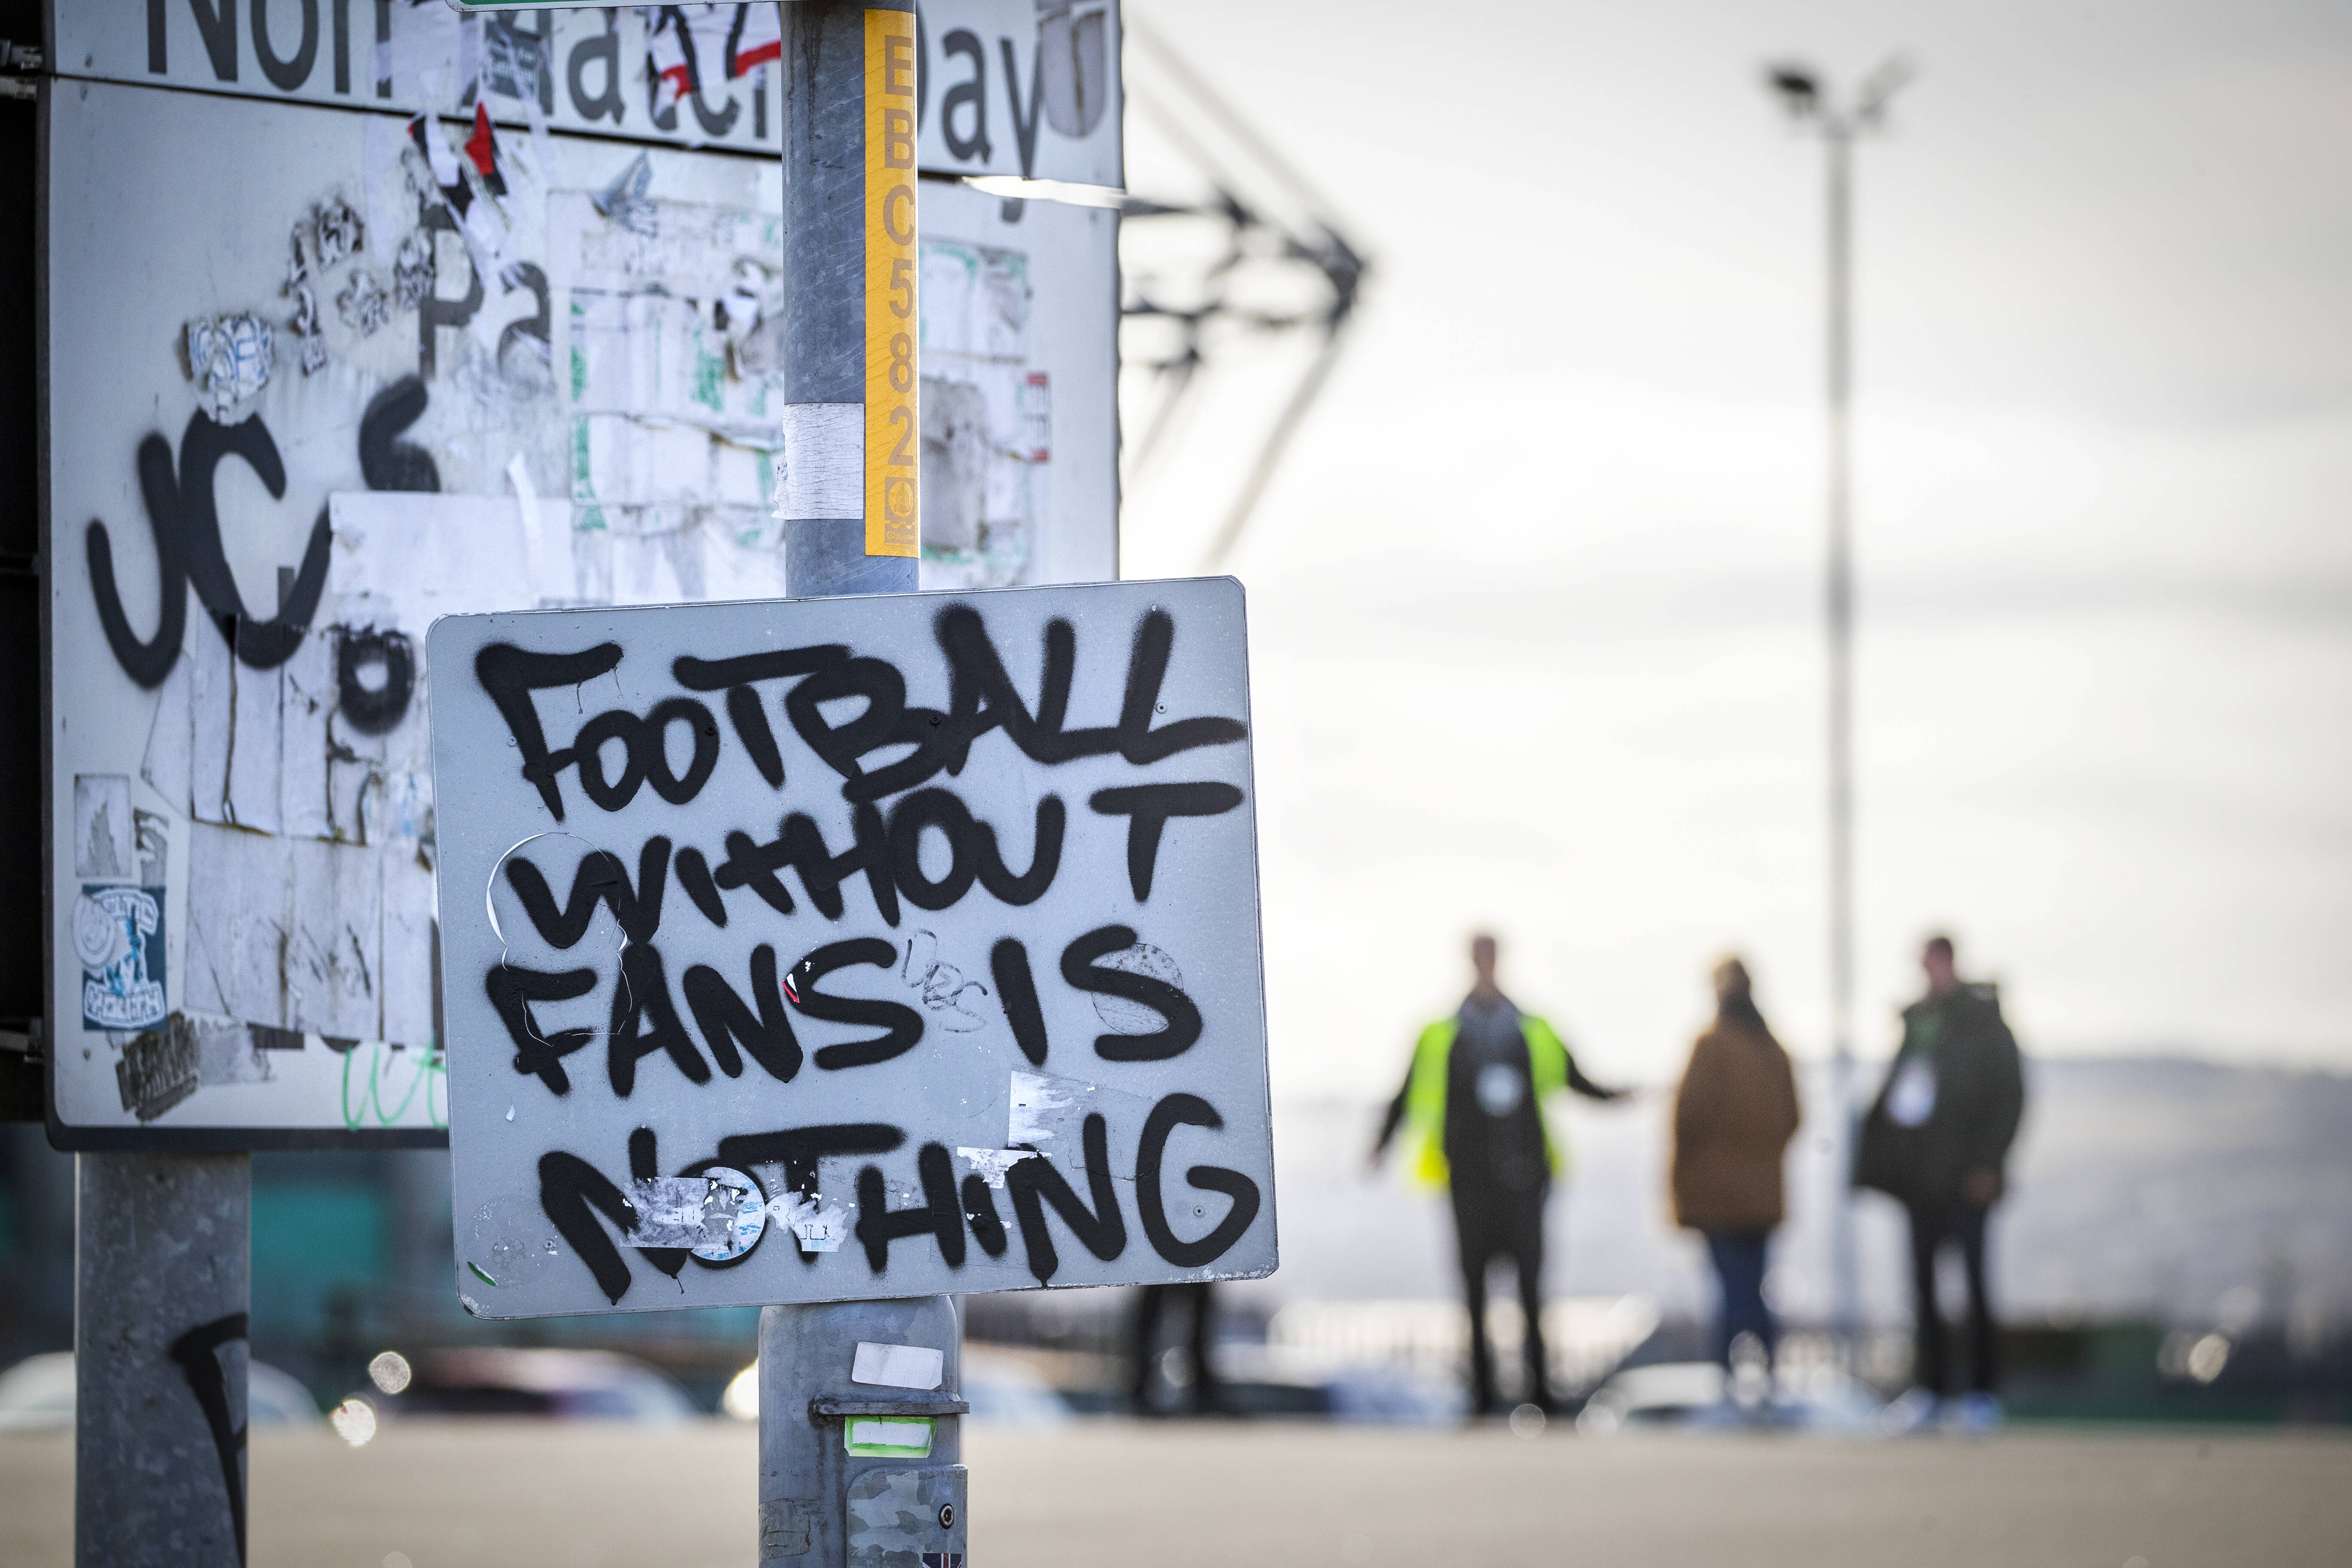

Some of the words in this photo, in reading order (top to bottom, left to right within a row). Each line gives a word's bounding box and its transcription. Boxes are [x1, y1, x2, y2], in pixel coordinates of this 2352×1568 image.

[887, 530, 915, 542] Glasgow
[475, 600, 1248, 823] FOOTBALL
[505, 781, 1245, 948] WITHOUT
[486, 935, 925, 1097] FANS
[989, 924, 1206, 1067] IS
[538, 1092, 1262, 1306] NOTHING
